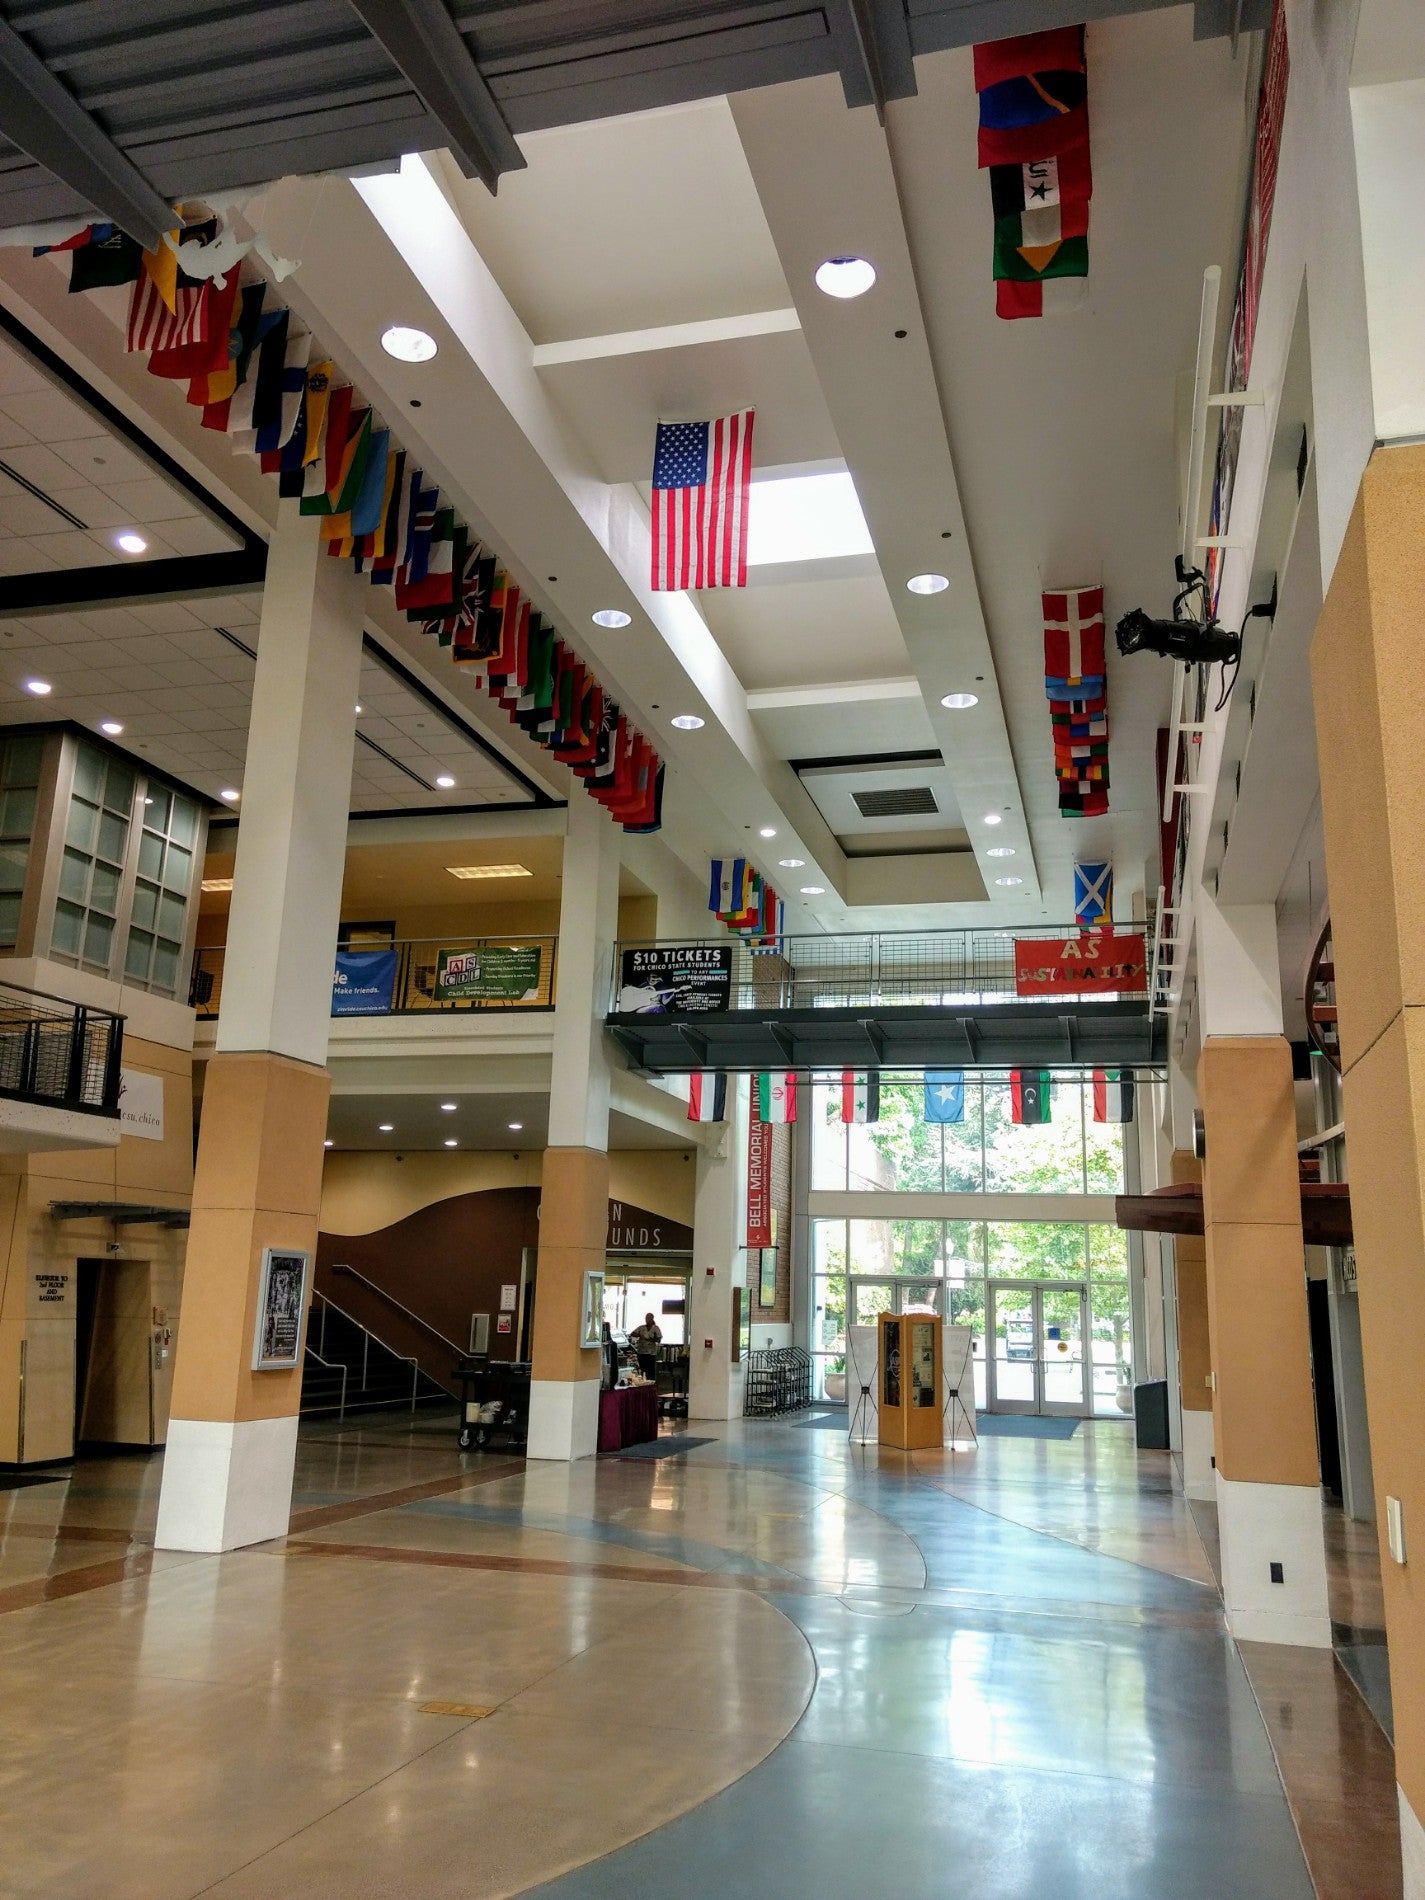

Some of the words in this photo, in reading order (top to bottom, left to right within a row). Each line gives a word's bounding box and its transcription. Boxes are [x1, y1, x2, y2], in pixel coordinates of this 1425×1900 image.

[634, 952, 658, 965] $10
[663, 950, 721, 962] TICKETS
[1061, 938, 1102, 958] AS
[446, 970, 479, 986] CDL
[1018, 963, 1144, 982] SUSTAINAILITY
[354, 986, 380, 994] friends.
[465, 989, 507, 997] Development
[752, 1074, 761, 1111] UNIO
[750, 1120, 762, 1190] MEMORIAL
[749, 1194, 761, 1228] BELL
[612, 1227, 661, 1246] UNDS
